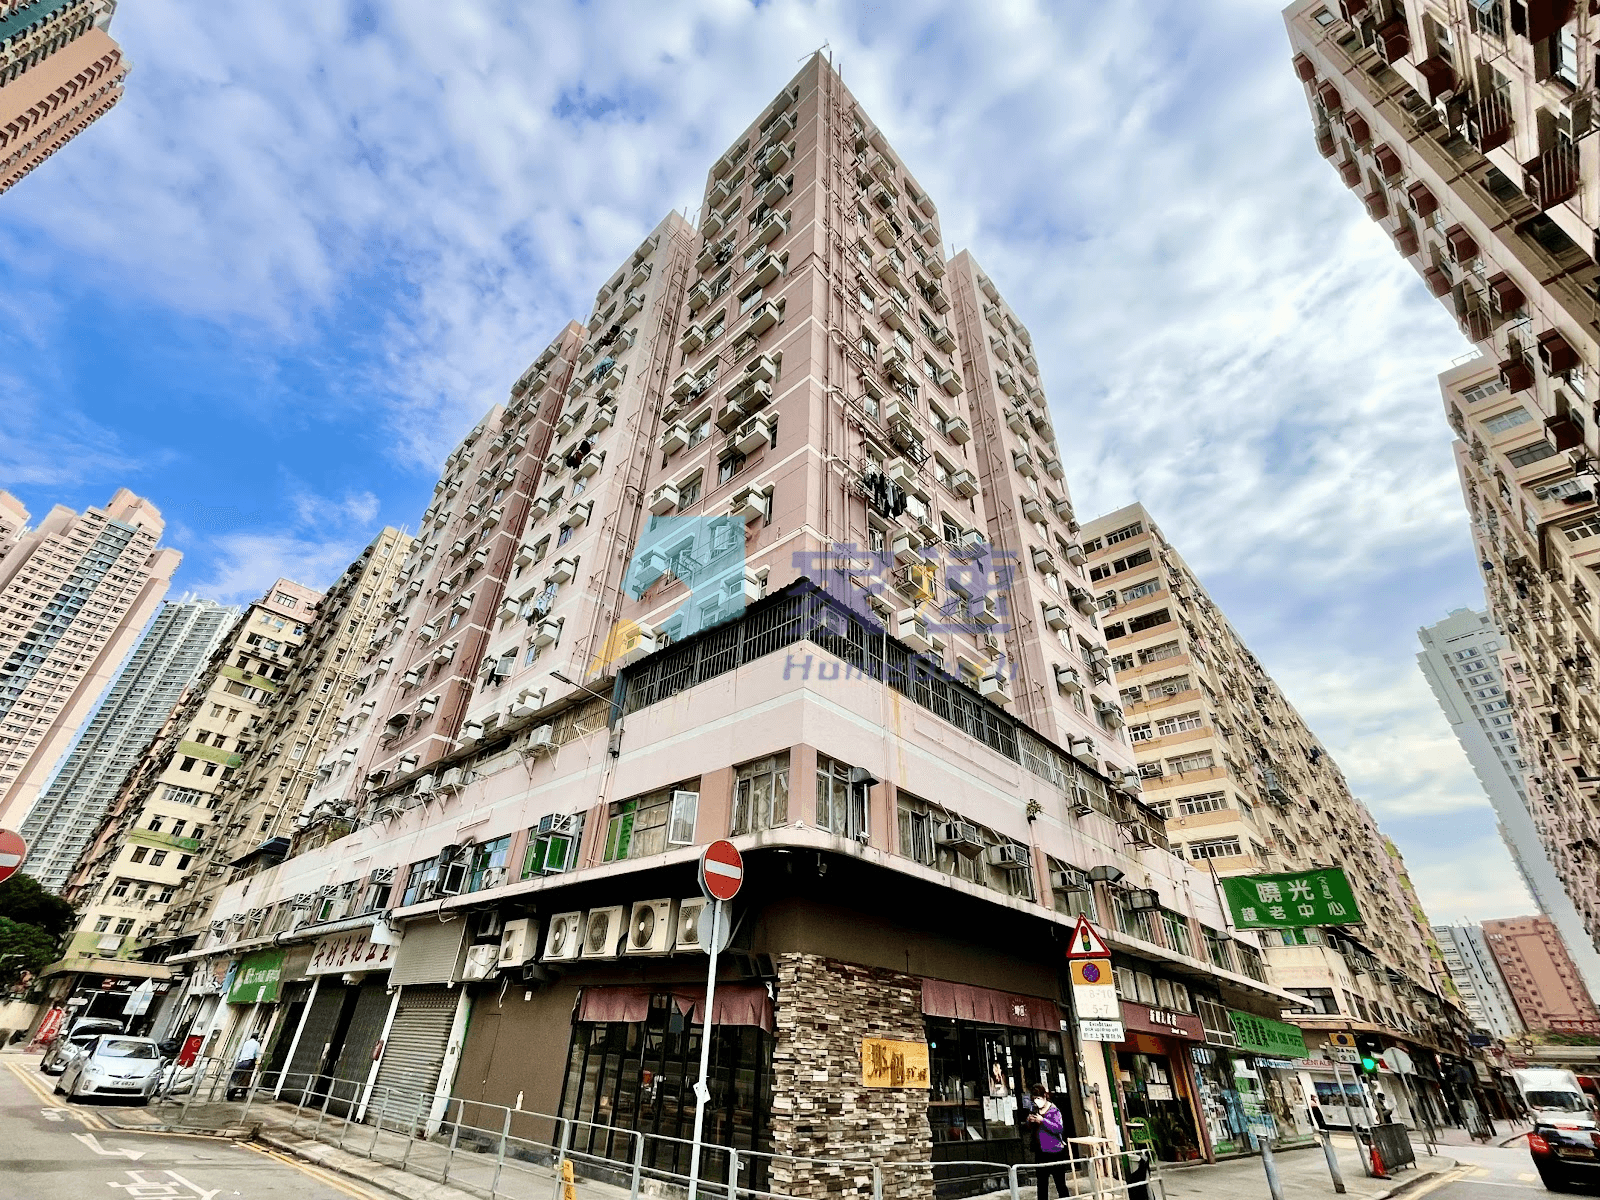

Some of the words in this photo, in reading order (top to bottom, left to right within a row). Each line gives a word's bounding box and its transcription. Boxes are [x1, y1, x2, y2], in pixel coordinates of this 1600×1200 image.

[1256, 880, 1315, 903] 曉光
[1241, 901, 1347, 921] 護老中心
[1089, 989, 1113, 999] 8-10
[1093, 1004, 1110, 1014] 5-7
